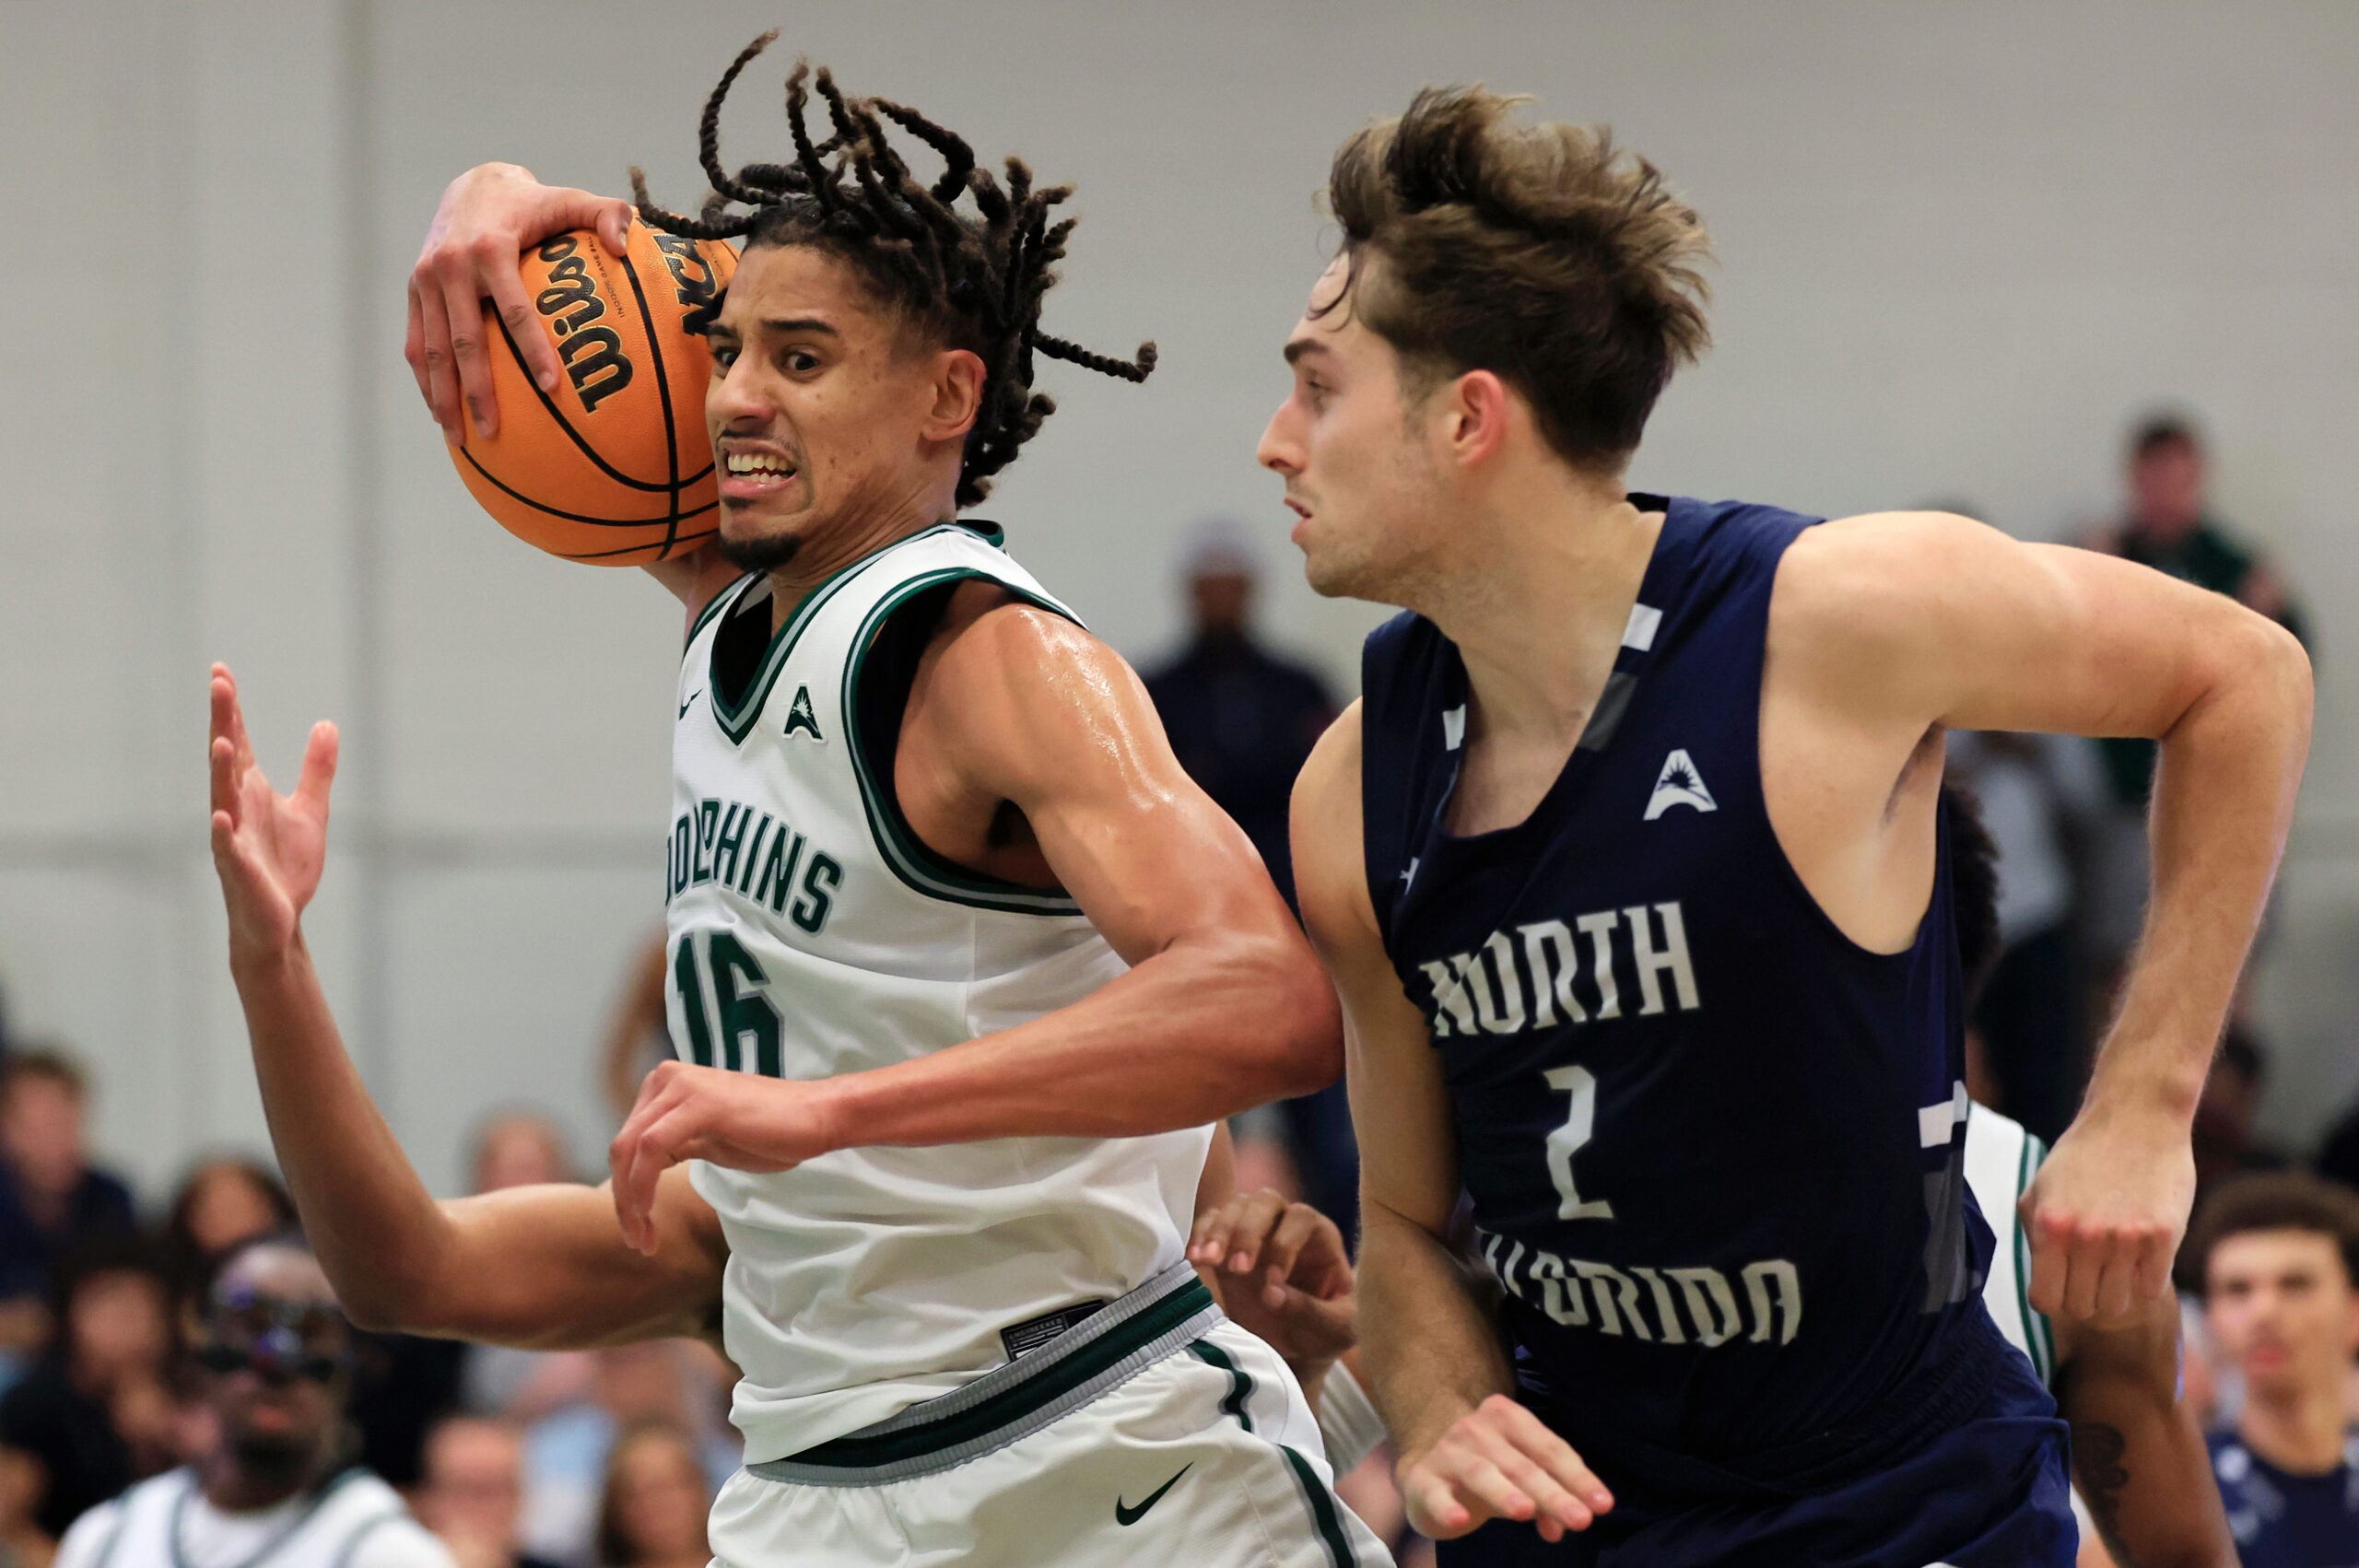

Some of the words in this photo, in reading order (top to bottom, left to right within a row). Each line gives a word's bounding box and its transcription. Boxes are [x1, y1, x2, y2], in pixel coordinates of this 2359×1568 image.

[536, 236, 633, 413] Wilso
[593, 255, 607, 278] GAME
[665, 798, 844, 937] OLPHINS
[675, 932, 786, 1081] 16
[1419, 901, 1701, 1037] NORTH
[1543, 1065, 1614, 1221] 2
